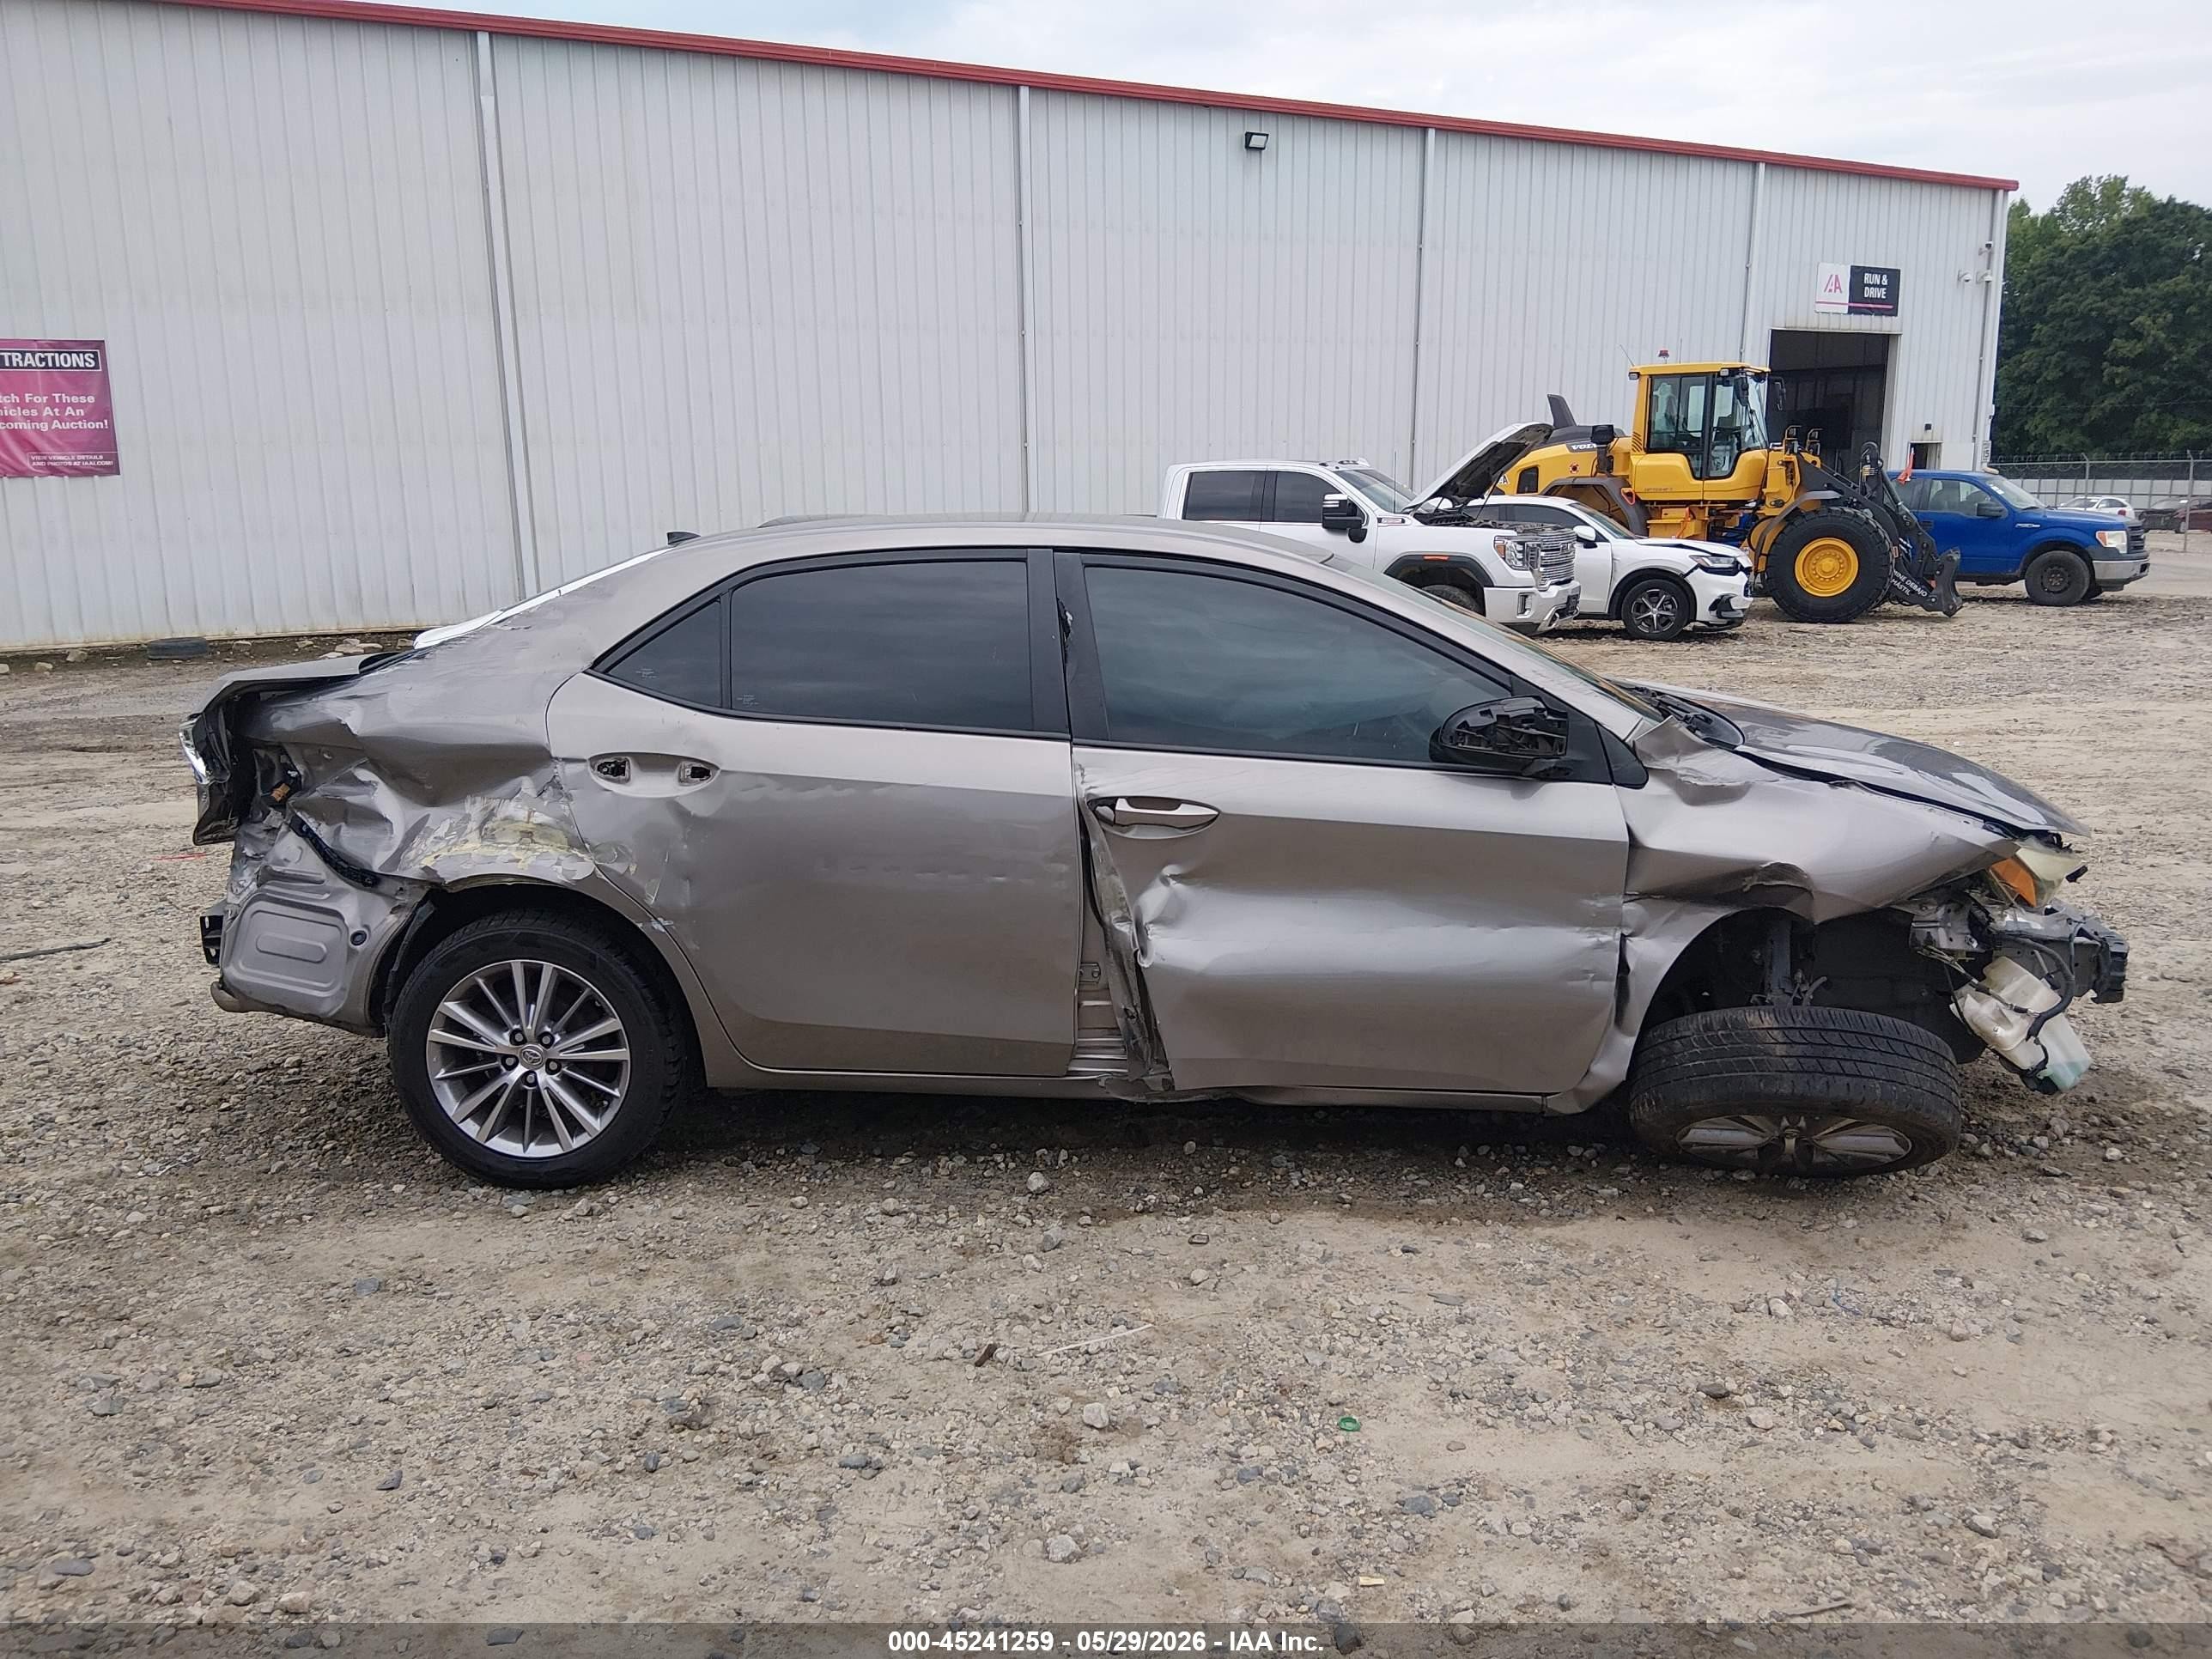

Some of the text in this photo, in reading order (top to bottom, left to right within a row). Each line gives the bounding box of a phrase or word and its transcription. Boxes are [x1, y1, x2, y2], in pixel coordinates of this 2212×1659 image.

[1863, 272, 1888, 285] RUN &
[1863, 287, 1887, 299] DRIVE
[0, 352, 95, 368] TRACTIONS
[25, 393, 49, 404] For
[52, 393, 95, 404] These
[42, 406, 60, 416] At
[64, 406, 84, 416] An
[52, 419, 109, 429] Auction!
[1905, 580, 1928, 597] DEBAJO
